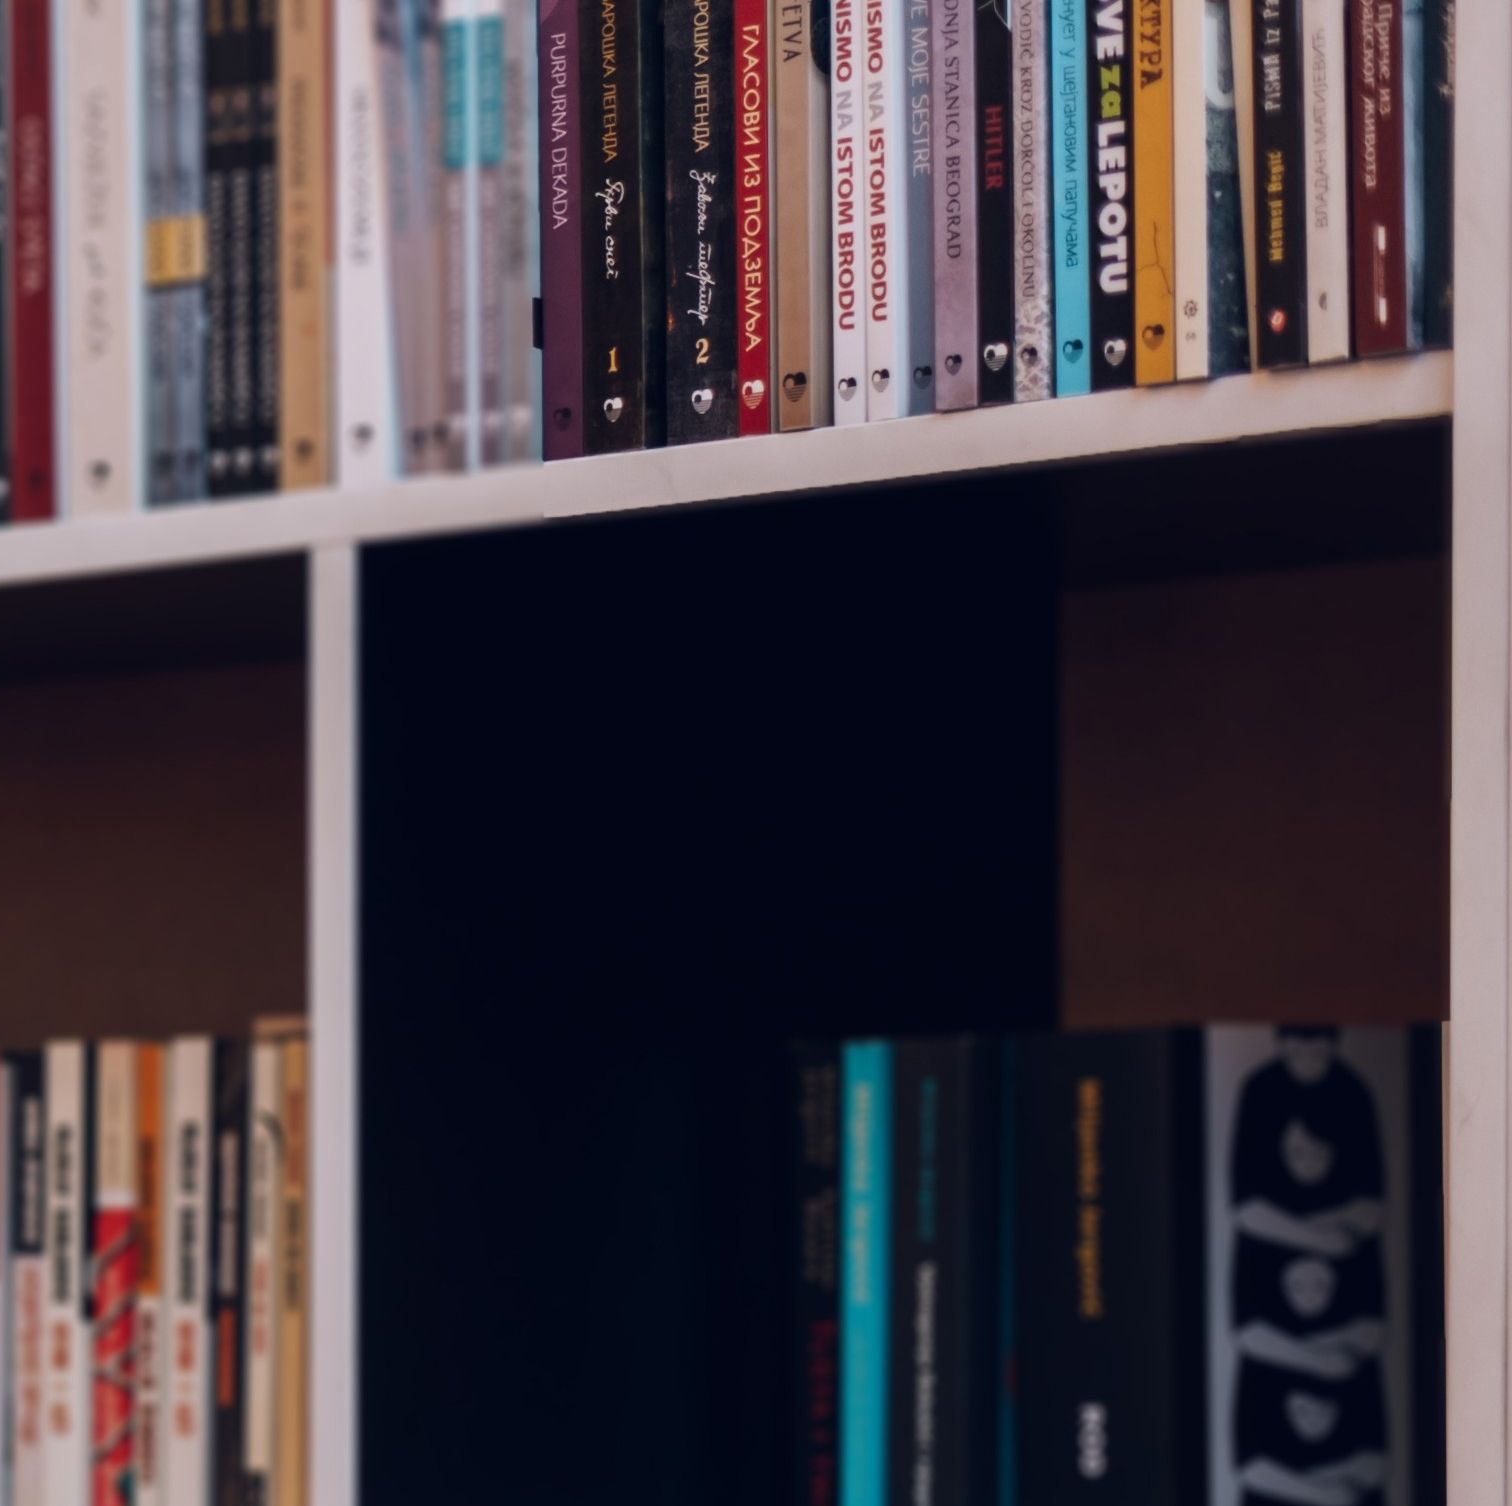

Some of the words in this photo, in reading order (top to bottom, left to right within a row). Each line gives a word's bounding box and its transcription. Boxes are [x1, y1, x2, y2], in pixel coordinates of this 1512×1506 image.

[692, 0, 711, 68] РОШКА
[782, 0, 804, 63] ETVA
[907, 27, 930, 89] MOJE
[1018, 1, 1036, 61] VODIČ
[1374, 4, 1393, 81] Приче
[549, 32, 568, 143] PURPURNA
[601, 83, 618, 164] ЛЕГЕНДА
[692, 72, 711, 154] ЛЕГЕНДА
[741, 24, 762, 144] ГЛАСОВИ
[835, 90, 852, 131] NA
[866, 81, 884, 123] NA
[942, 55, 961, 150] STANICA
[1018, 66, 1034, 113] KROZ
[1059, 64, 1079, 174] шејтановим
[1099, 64, 1121, 119] za
[1378, 88, 1392, 116] из
[742, 152, 762, 188] ИЗ
[867, 127, 886, 218] ISTOM
[911, 94, 931, 179] SESTRE
[983, 104, 1004, 192] HITLER
[1359, 97, 1377, 189] живота
[551, 146, 569, 231] DEKADA
[836, 136, 855, 226] ISTOM
[944, 155, 963, 260] BEOGRAD
[1060, 179, 1080, 268] папучама
[1097, 119, 1128, 294] LEPOTU
[741, 195, 763, 353] ПОДЗЕМЉА
[837, 232, 856, 332] BRODU
[868, 223, 888, 323] BRODU
[1021, 212, 1035, 299] OKOLINU
[607, 345, 620, 374] 1
[695, 337, 711, 365] 2
